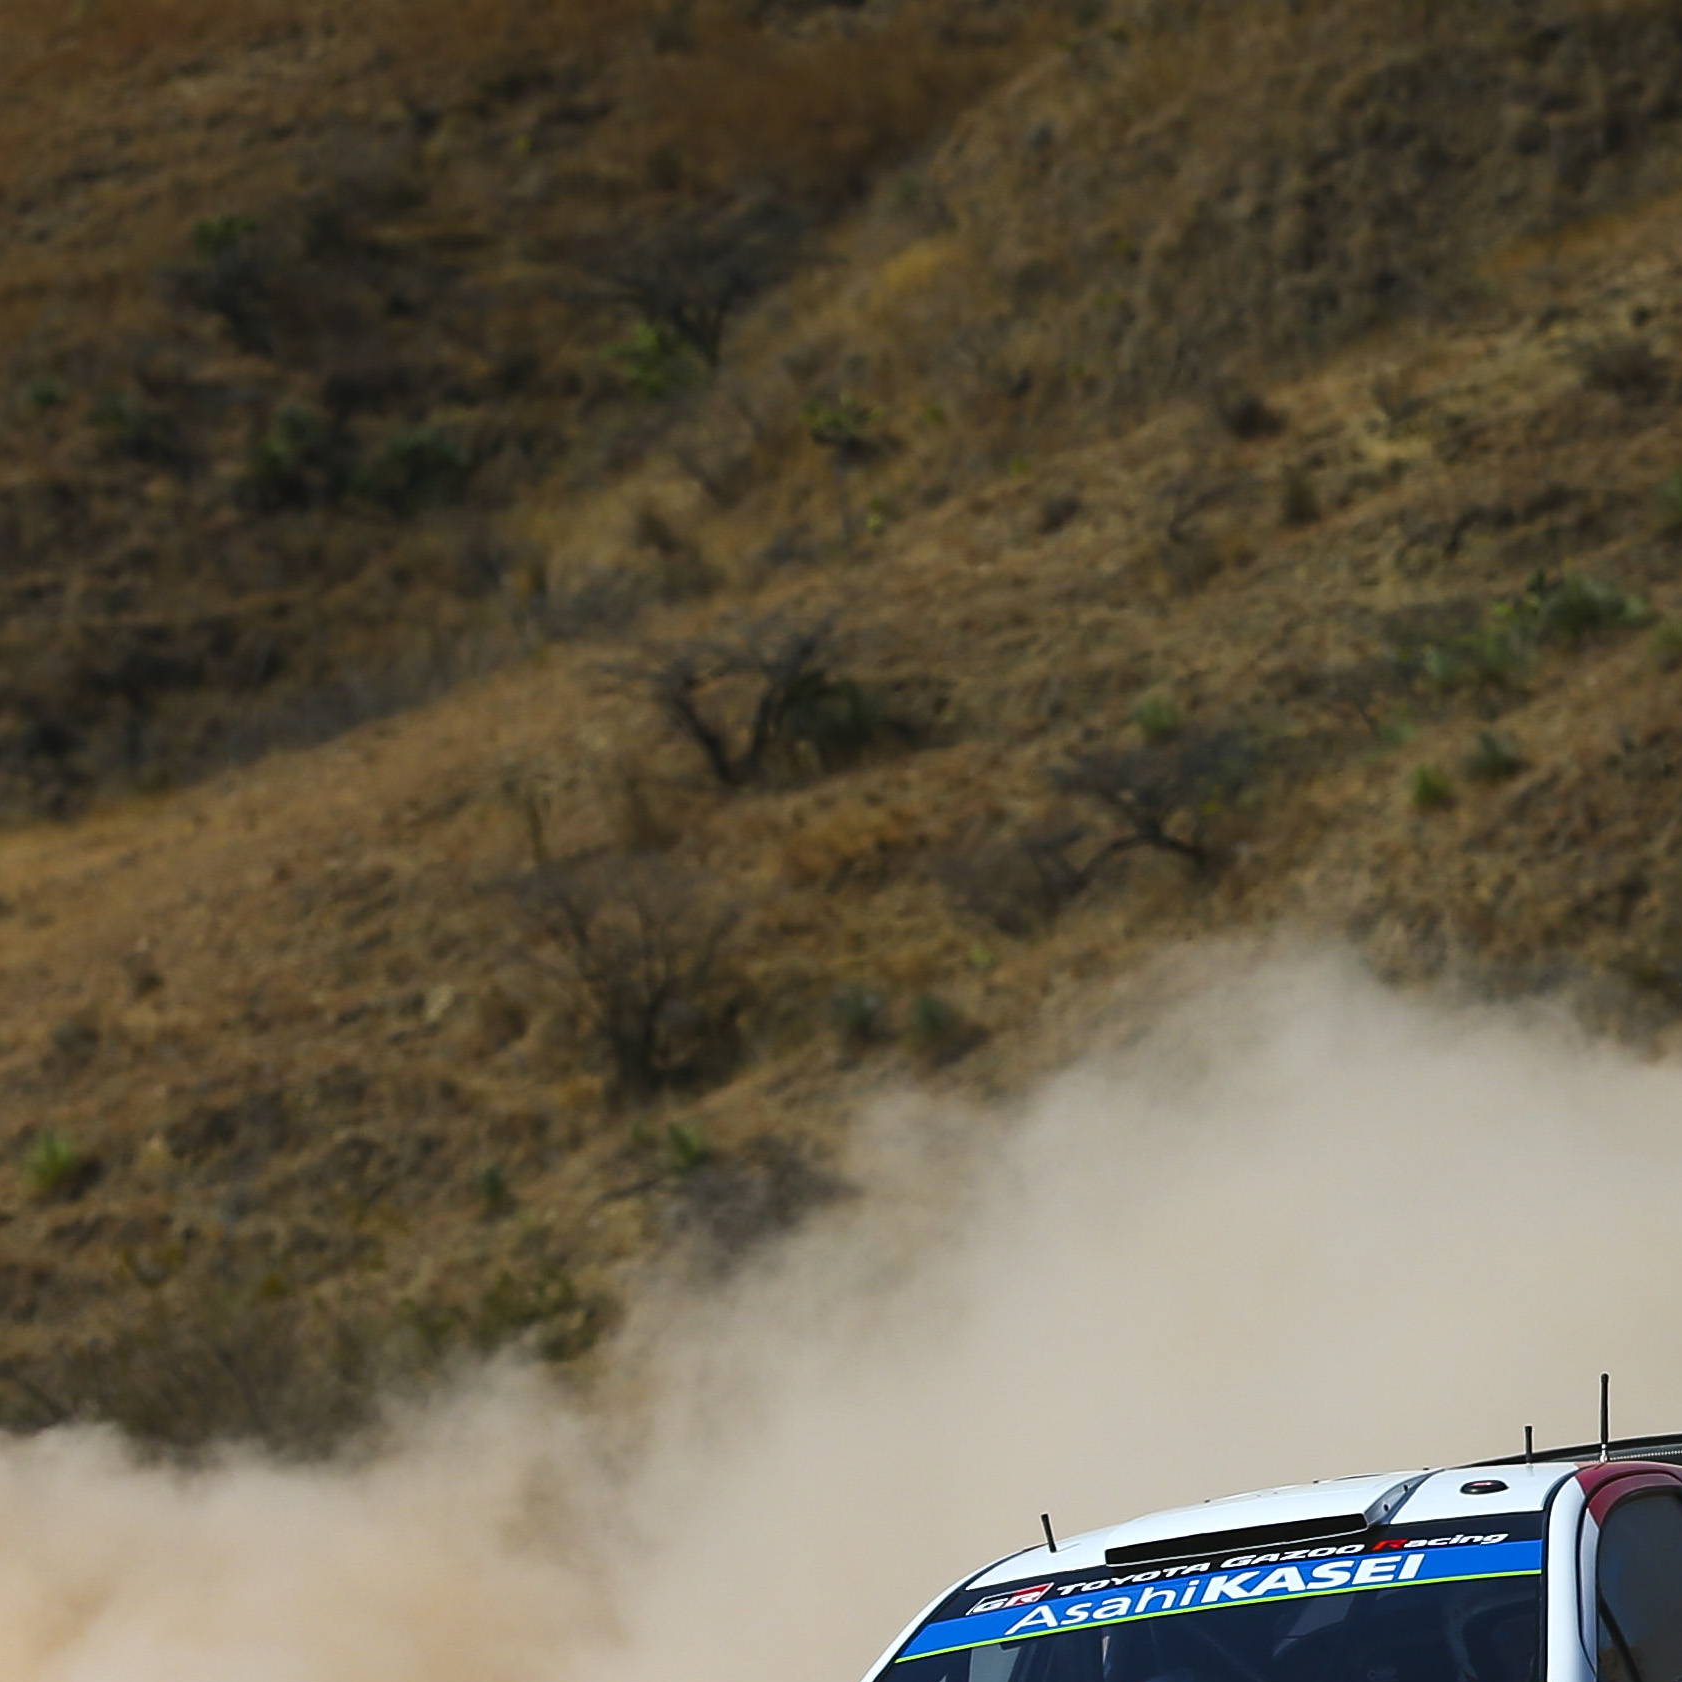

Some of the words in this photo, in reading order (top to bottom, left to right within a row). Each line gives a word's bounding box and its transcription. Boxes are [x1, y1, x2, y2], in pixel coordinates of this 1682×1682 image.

[1056, 1563, 1210, 1596] TOYOTA
[1220, 1543, 1366, 1569] GAZOO
[1372, 1532, 1510, 1552] Racing
